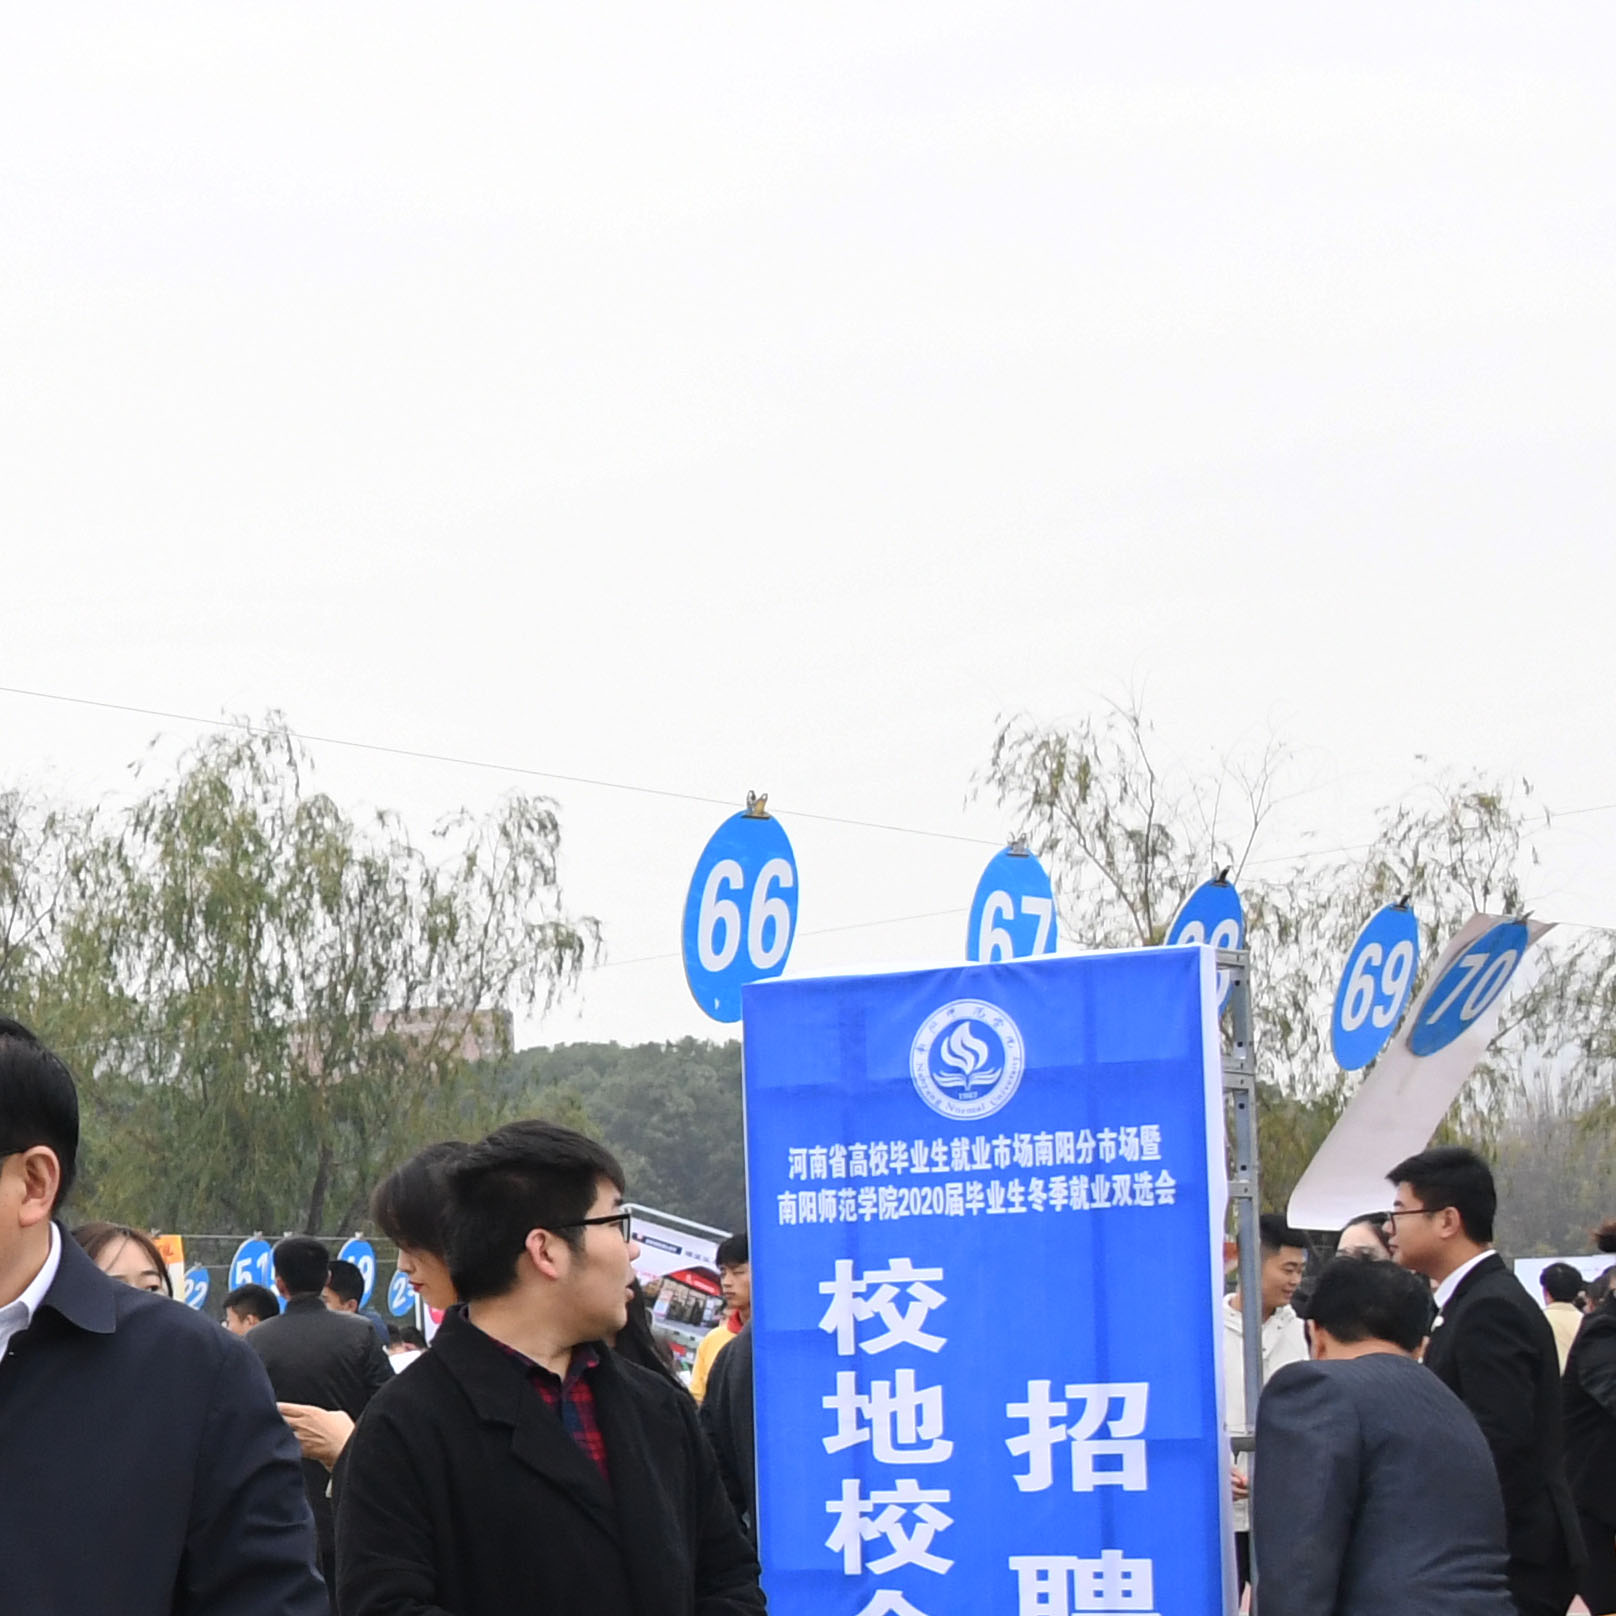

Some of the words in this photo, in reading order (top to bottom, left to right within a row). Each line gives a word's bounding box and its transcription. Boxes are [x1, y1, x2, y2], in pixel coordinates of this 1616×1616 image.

[697, 857, 793, 973] 66
[978, 890, 1053, 963] 67
[1340, 940, 1414, 1032] 69
[1426, 949, 1518, 1025] 70
[788, 1124, 1161, 1181] 河南省高校毕业生就业市场南阳分市场暨
[777, 1169, 1176, 1226] 南阳师范学院2020届毕业生冬季就业双选会
